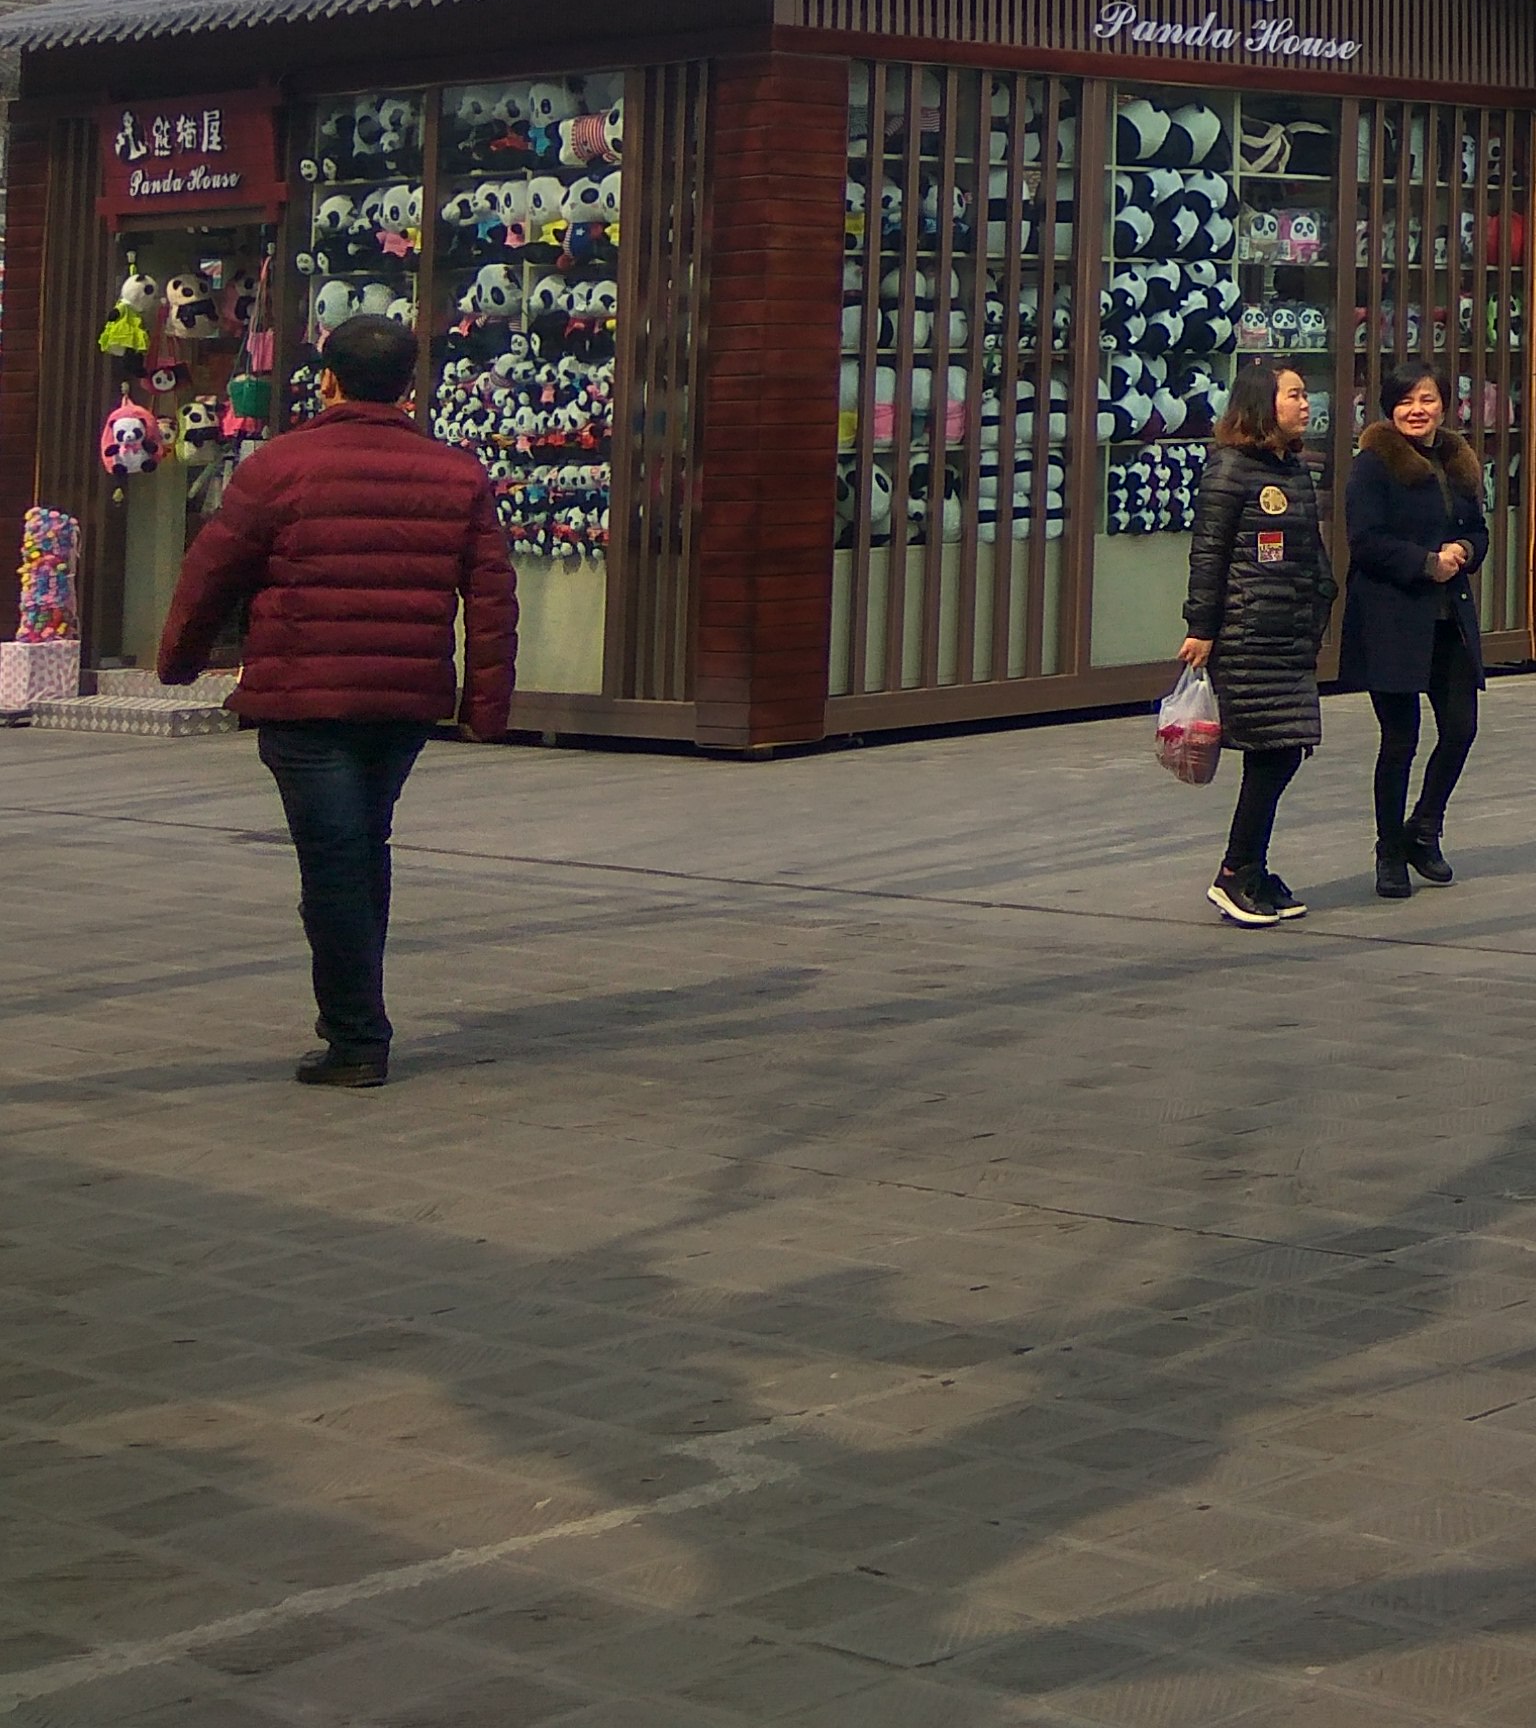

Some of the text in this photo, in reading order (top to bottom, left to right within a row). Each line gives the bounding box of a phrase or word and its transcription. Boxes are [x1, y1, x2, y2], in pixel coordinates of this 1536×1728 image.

[1094, 0, 1362, 60] Panda House
[152, 110, 222, 156] 熊猫屋
[129, 165, 239, 197] Panda House
